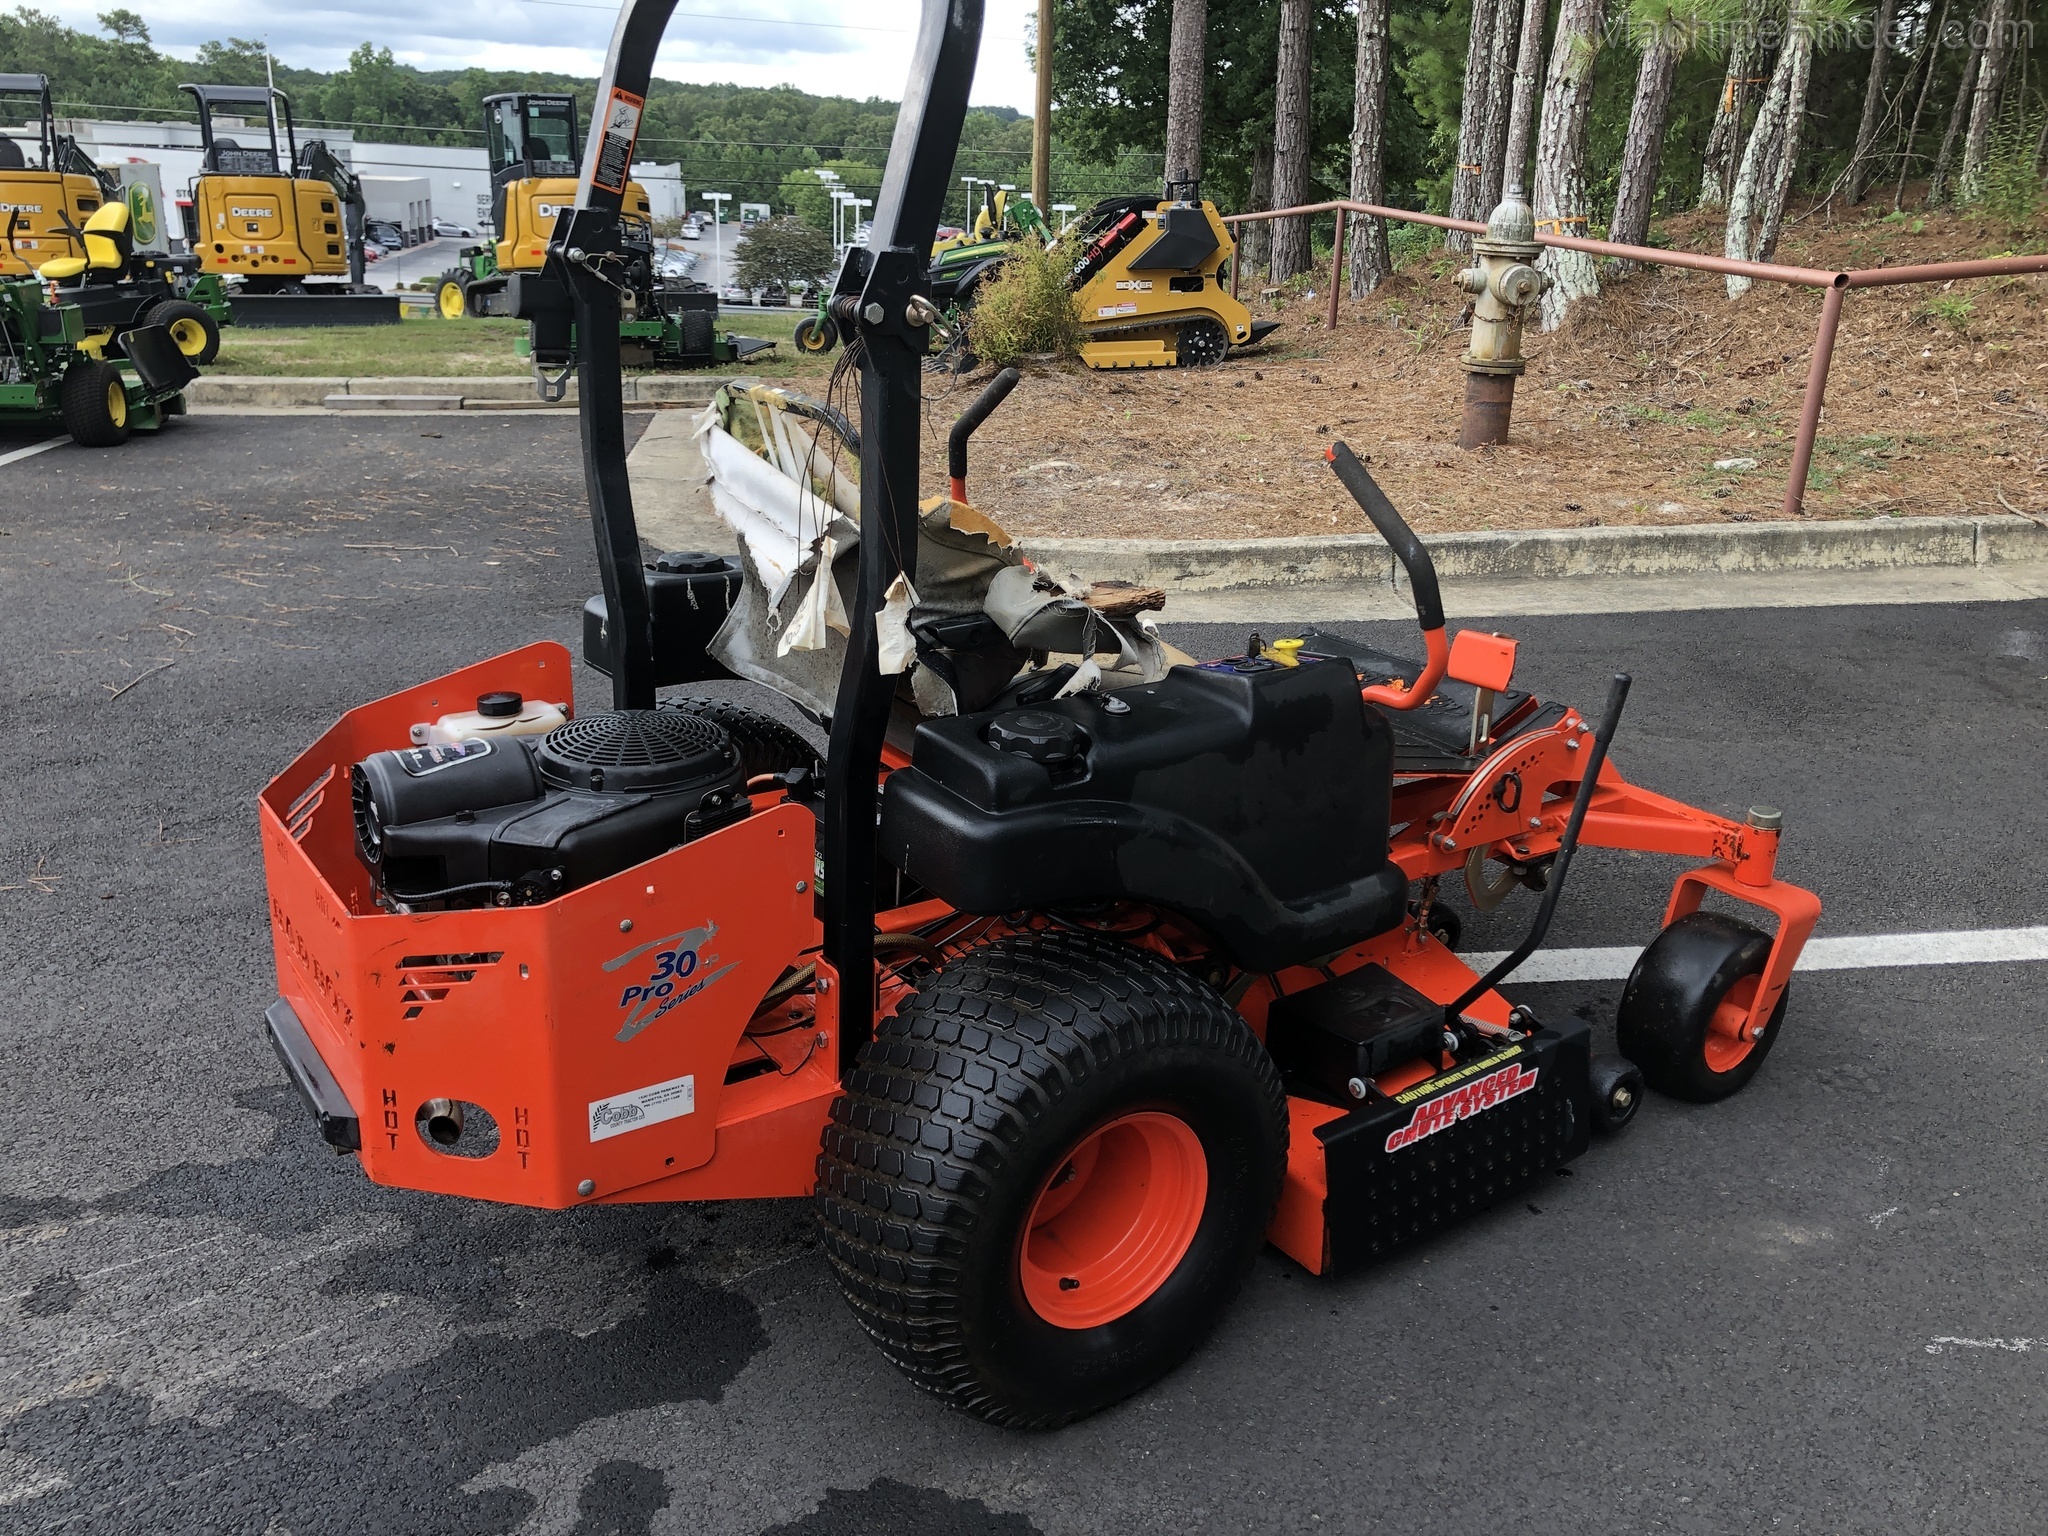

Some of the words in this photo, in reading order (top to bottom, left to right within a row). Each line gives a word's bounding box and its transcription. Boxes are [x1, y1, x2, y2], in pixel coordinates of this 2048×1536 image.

[232, 207, 273, 218] DEERE
[477, 194, 492, 204] SER
[1116, 280, 1153, 291] BOXER
[650, 950, 698, 982] 30
[620, 982, 674, 1008] Pro
[654, 978, 705, 1019] Series
[1395, 1082, 1438, 1104] CAUTION:
[1435, 1073, 1462, 1088] OPERATE
[1461, 1065, 1481, 1077] WITH
[1498, 1045, 1523, 1060] CLOSED
[1386, 1108, 1457, 1152] CHUTE
[1460, 1069, 1539, 1120] SYSTEM
[1411, 1063, 1521, 1125] ADVANCED
[383, 1088, 399, 1151] HOT
[600, 1104, 638, 1125] Cobb
[514, 1106, 530, 1170] HOT
